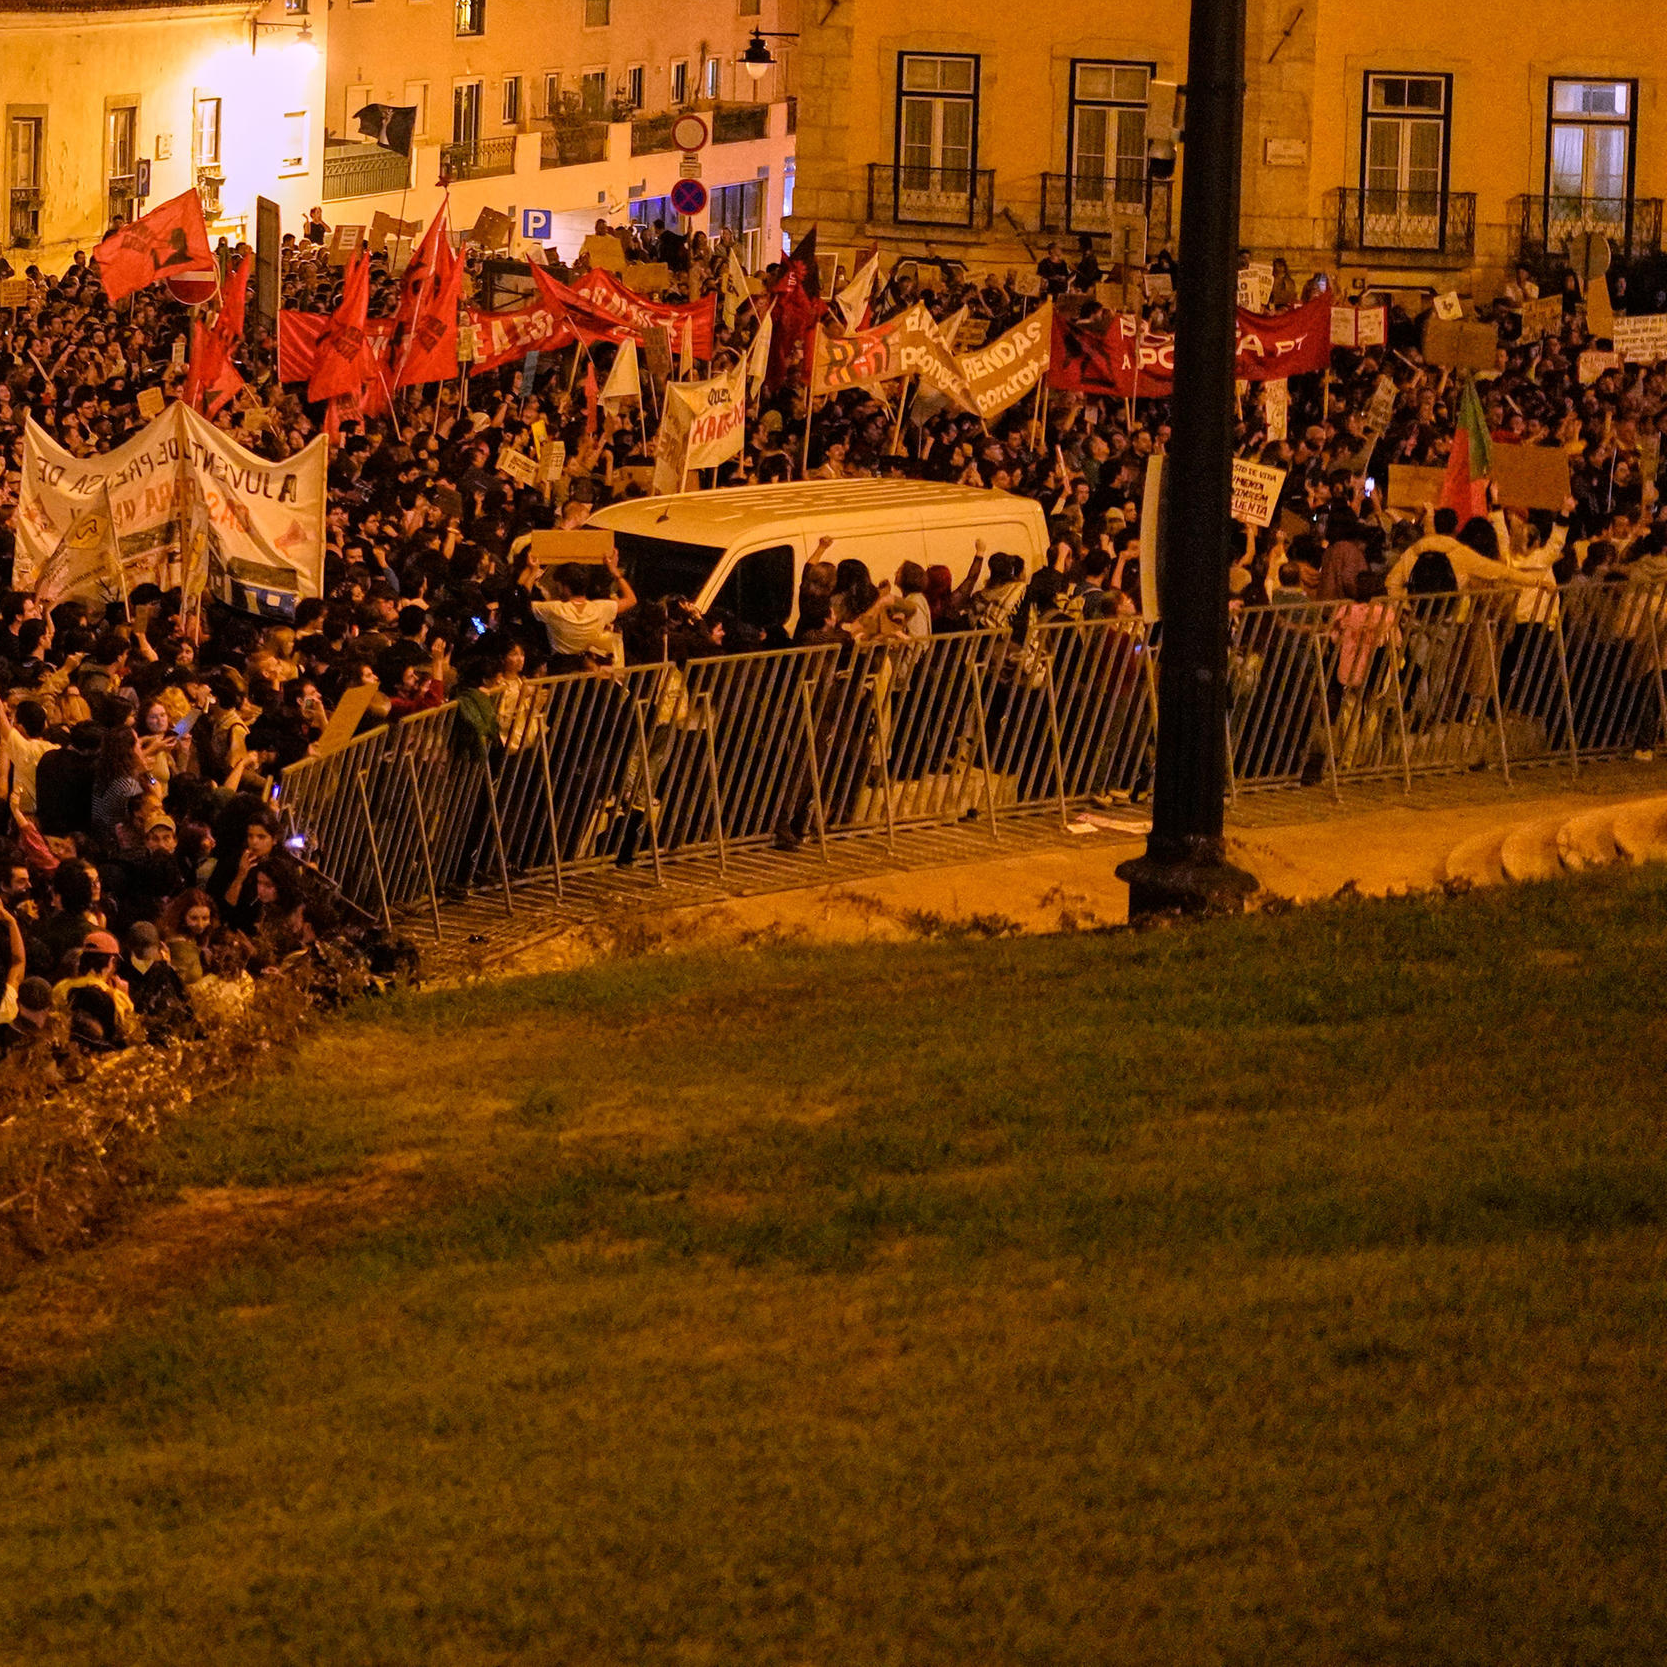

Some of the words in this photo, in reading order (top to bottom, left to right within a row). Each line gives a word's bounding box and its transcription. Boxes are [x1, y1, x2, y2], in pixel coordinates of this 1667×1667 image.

[138, 163, 148, 195] P
[528, 210, 547, 237] P
[962, 320, 1043, 382] RENDAS
